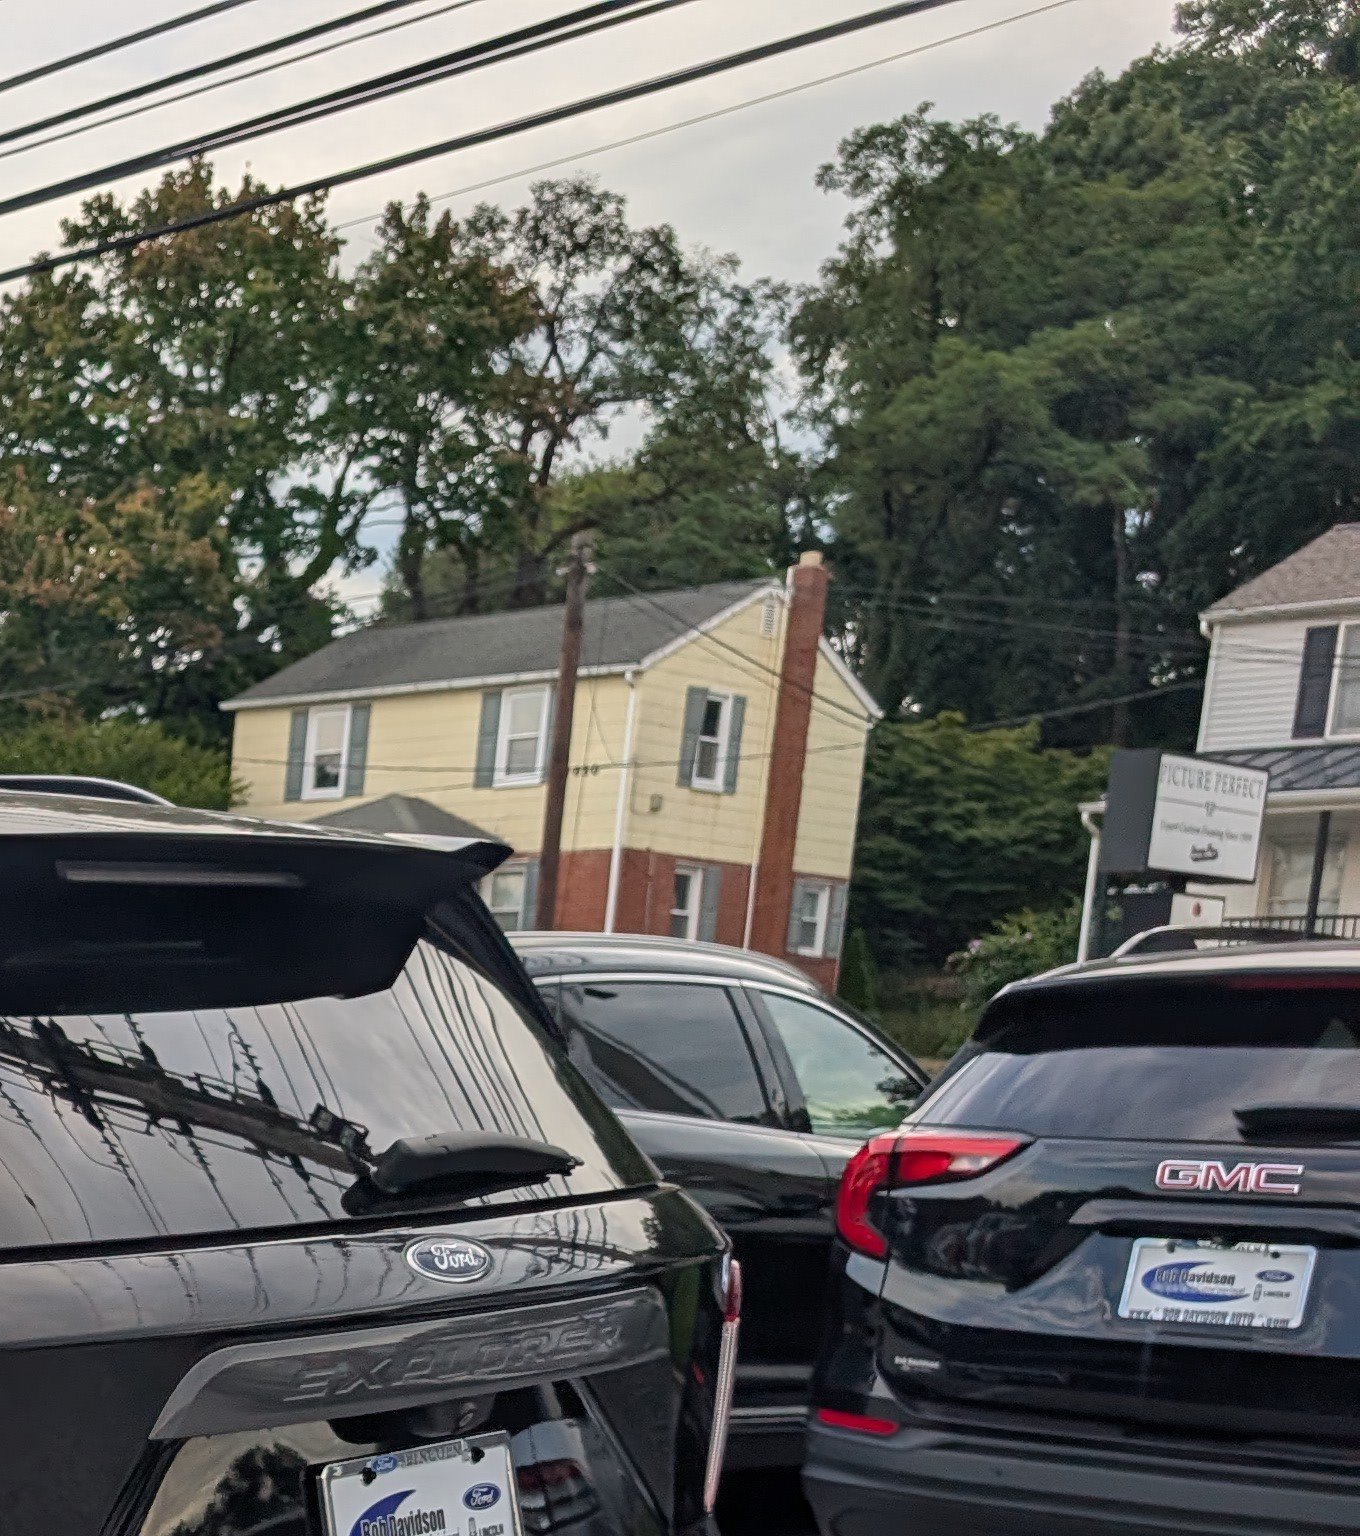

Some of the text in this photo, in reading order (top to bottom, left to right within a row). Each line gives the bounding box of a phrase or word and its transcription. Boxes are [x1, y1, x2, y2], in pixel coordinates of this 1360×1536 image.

[1160, 764, 1263, 799] PICTURE PERFECT
[1155, 1160, 1305, 1195] GMC
[430, 1243, 479, 1270] Ford
[1180, 1269, 1236, 1286] Davidson
[283, 1319, 624, 1402] EXPLORER
